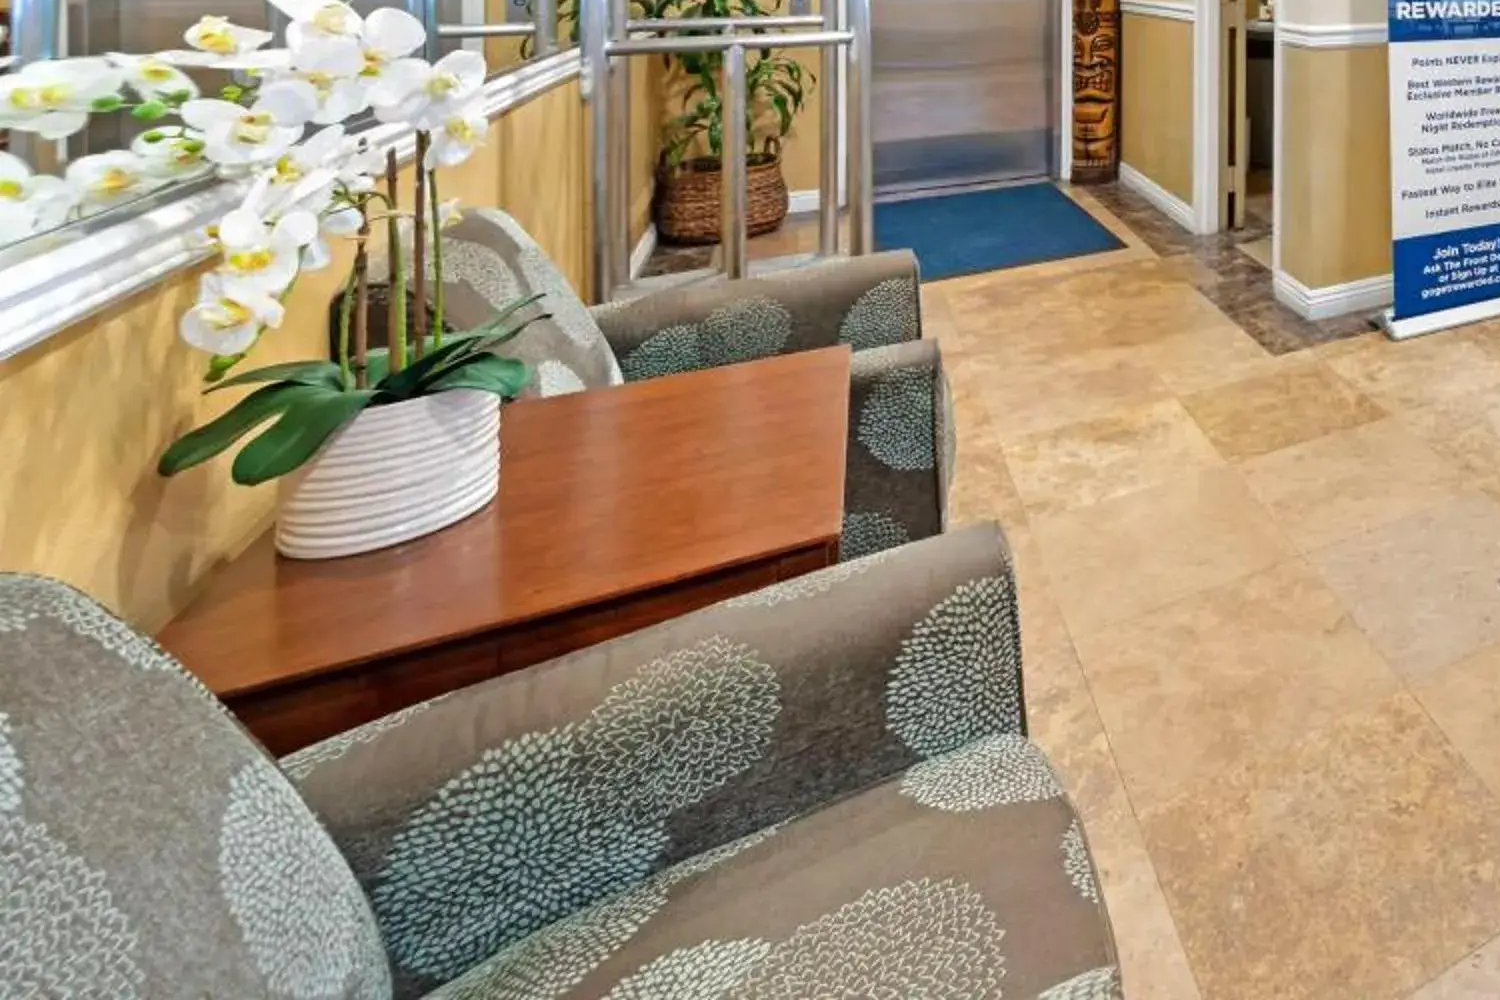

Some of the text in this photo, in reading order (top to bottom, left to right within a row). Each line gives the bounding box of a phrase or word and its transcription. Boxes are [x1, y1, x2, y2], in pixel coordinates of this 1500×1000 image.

[1411, 57, 1443, 67] Points
[1445, 55, 1479, 65] NEVER
[1407, 79, 1429, 89] Best
[1432, 78, 1472, 87] Western
[1407, 90, 1452, 101] Exclusive
[1454, 86, 1493, 97] Member
[1425, 107, 1500, 121] Worldwide Free
[1421, 123, 1449, 134] Night
[1407, 147, 1439, 157] Status
[1476, 140, 1489, 149] No
[1401, 187, 1438, 200] Fastest
[1440, 184, 1461, 195] Way
[1463, 182, 1474, 192] to
[1425, 206, 1459, 219] Instant
[1432, 238, 1500, 261] Join Today!
[1423, 263, 1441, 275] Ask
[1444, 261, 1461, 270] The
[1463, 255, 1488, 266] Front
[1438, 264, 1499, 283] or Sign Up at
